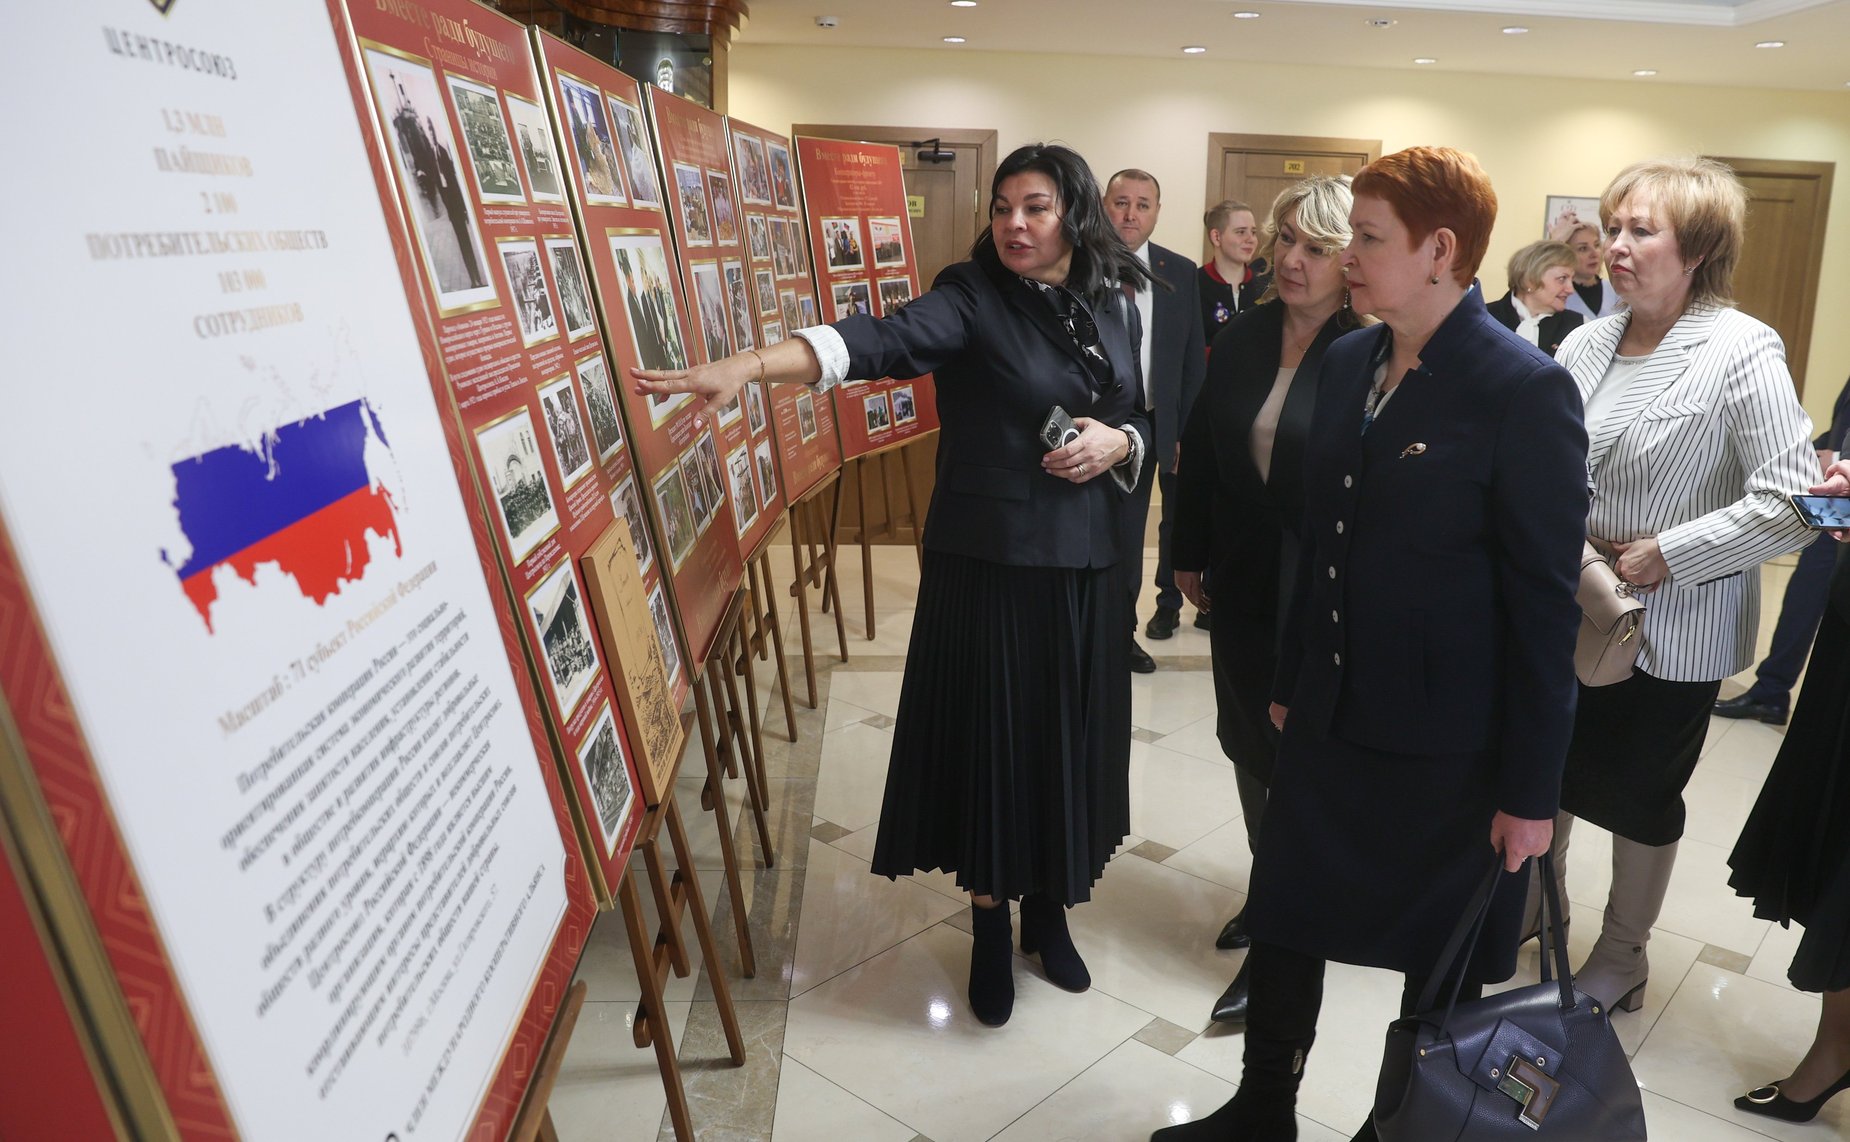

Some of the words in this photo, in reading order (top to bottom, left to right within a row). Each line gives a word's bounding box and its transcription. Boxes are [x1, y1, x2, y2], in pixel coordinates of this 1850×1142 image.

[103, 25, 238, 80] ЦЕНТРОСОЮЗ
[85, 232, 267, 261] ПОТРЕБИТЕЛЬСКИХ
[193, 303, 303, 339] СОТРУДНИКОВ
